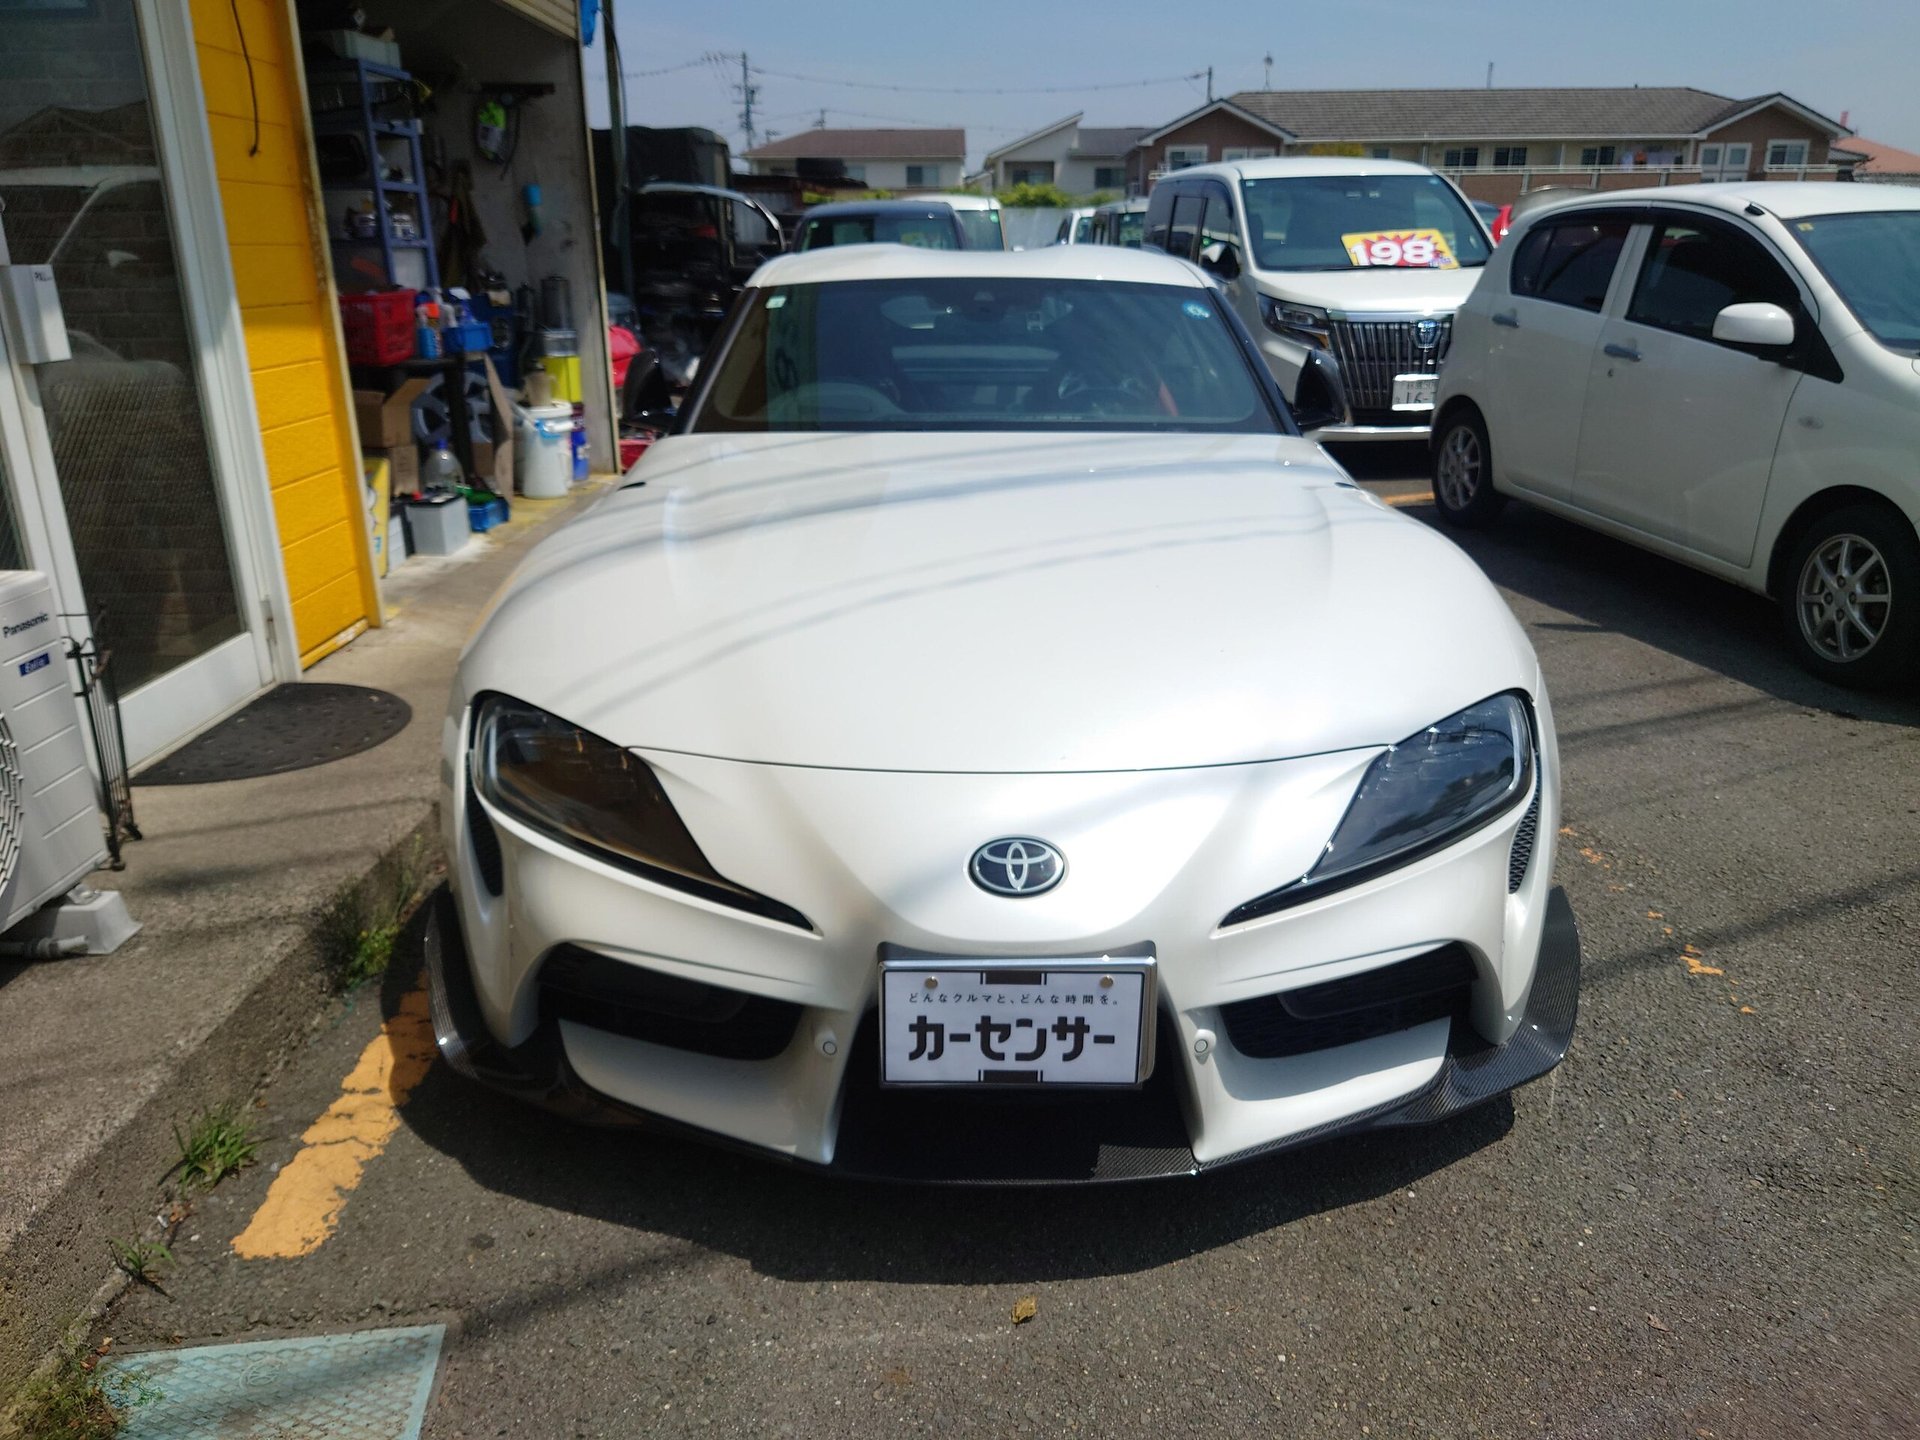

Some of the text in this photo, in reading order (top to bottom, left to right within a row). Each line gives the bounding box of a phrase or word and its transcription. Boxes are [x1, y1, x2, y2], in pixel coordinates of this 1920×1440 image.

[1350, 240, 1434, 266] 198
[3, 612, 48, 638] Panasonic
[909, 993, 1118, 1004] どんなクルマと、どんな時間を。
[908, 1015, 1115, 1062] カーセンサー
